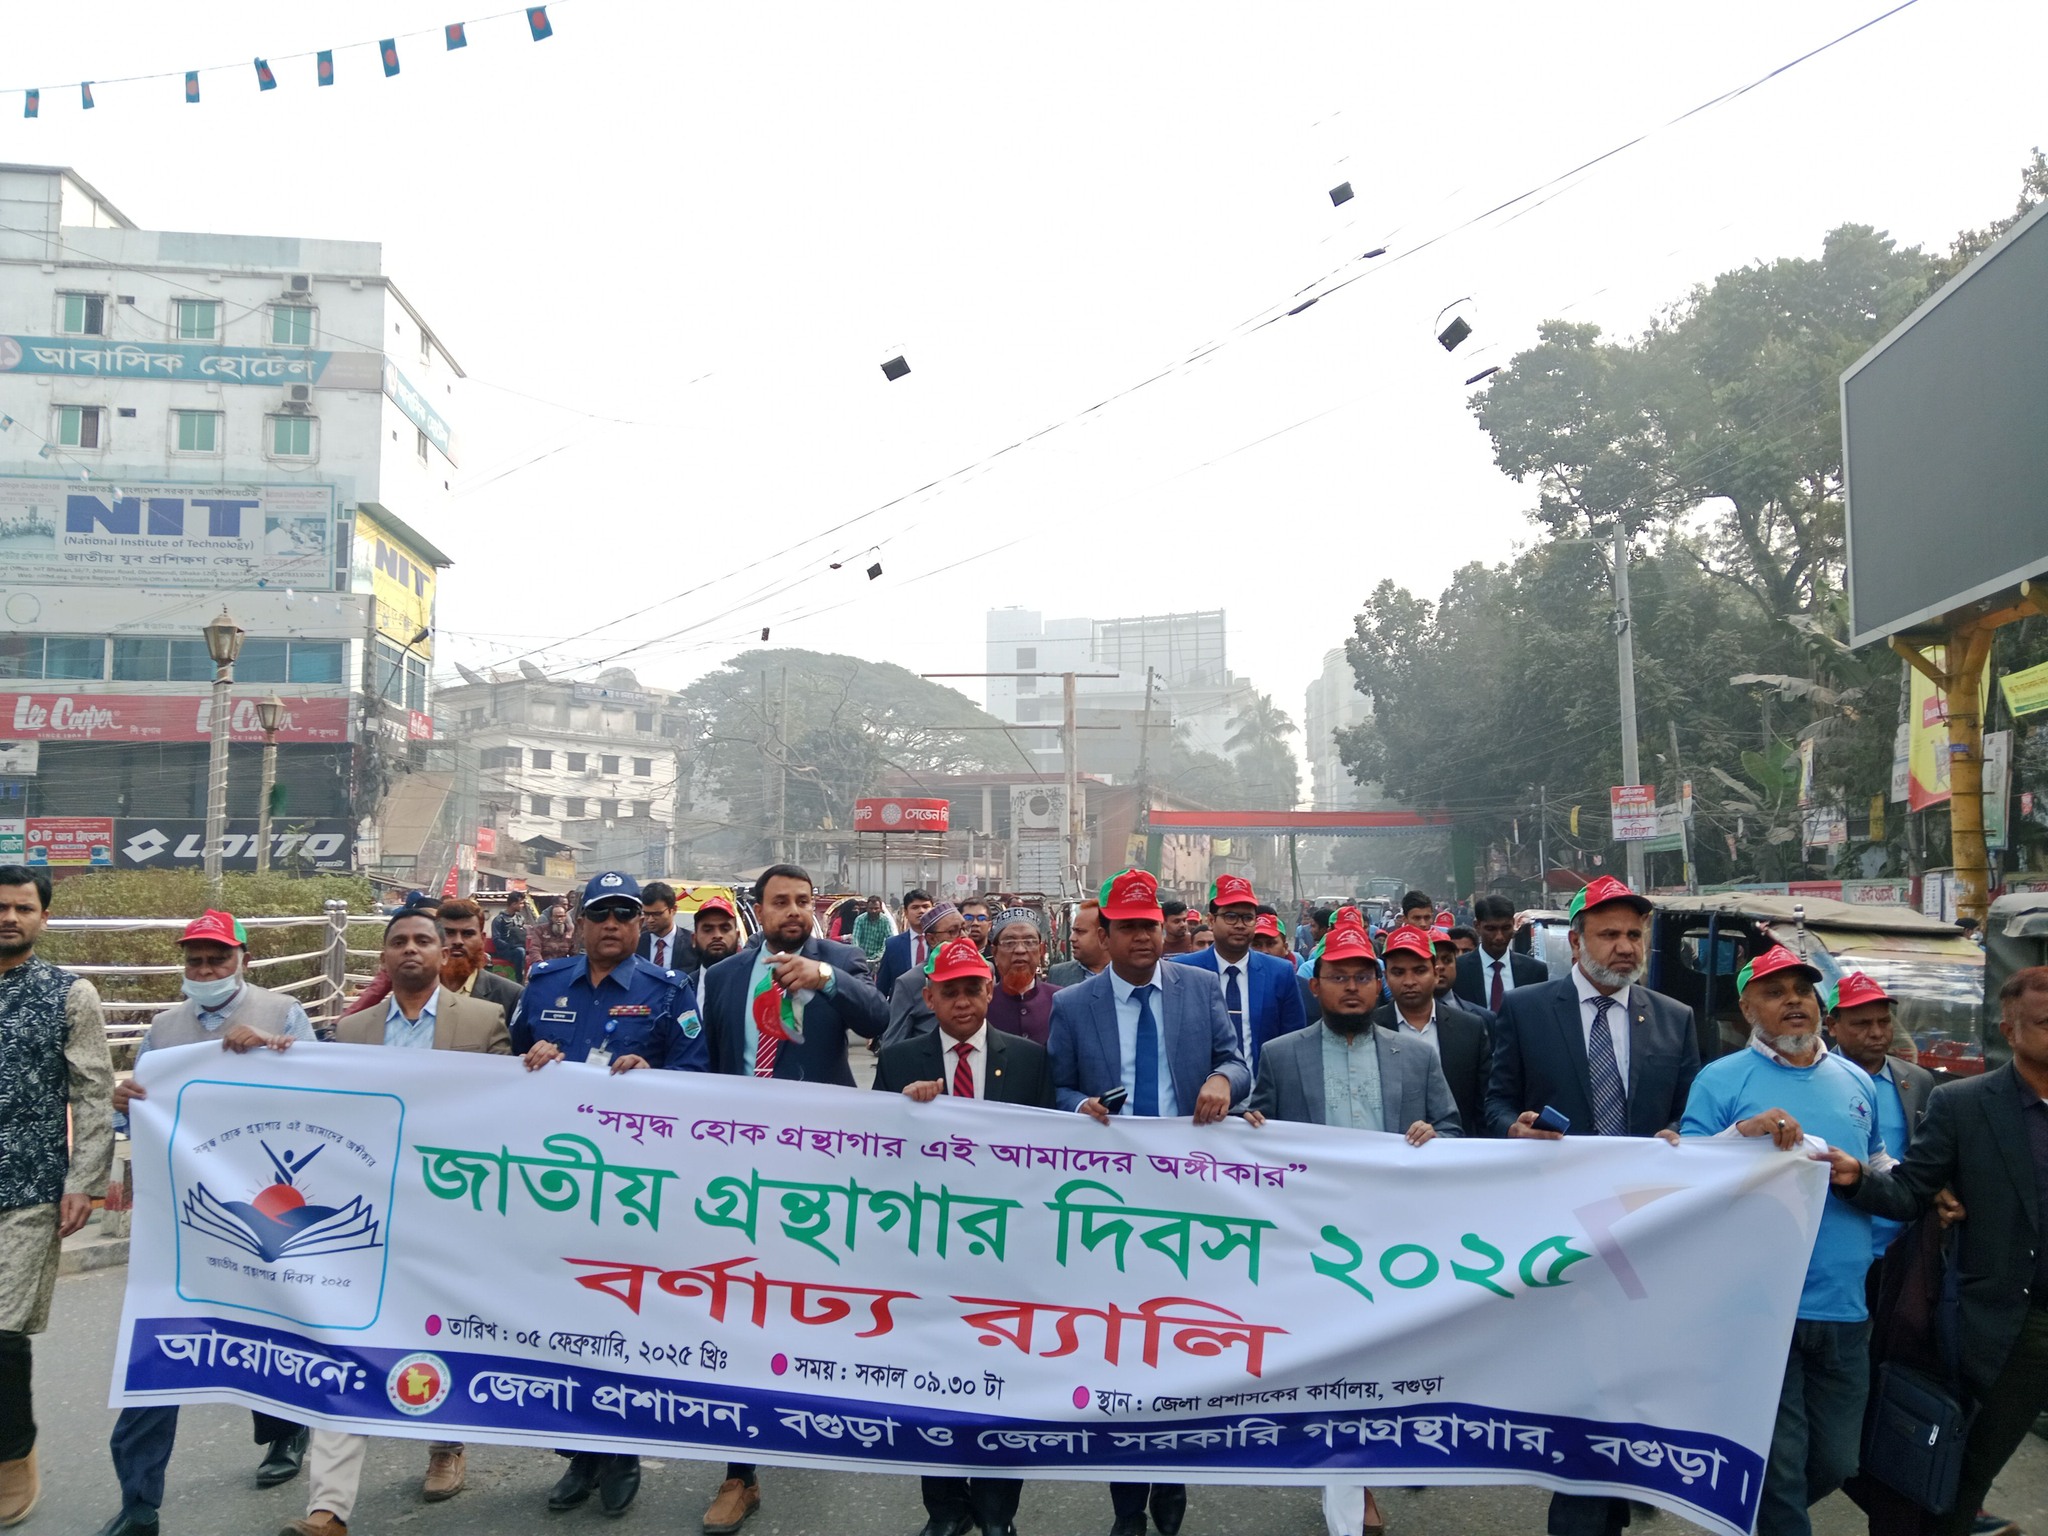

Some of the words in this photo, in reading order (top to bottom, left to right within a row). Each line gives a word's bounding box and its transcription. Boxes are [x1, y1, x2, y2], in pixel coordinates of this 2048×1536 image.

[31, 345, 185, 374] আবাসিক
[200, 352, 316, 380] হোটেল
[66, 495, 259, 537] NIT
[64, 535, 118, 546] (National
[120, 537, 171, 548] Institute
[172, 538, 184, 548] of
[187, 539, 254, 551] Technology)
[64, 551, 113, 563] জাতীয়
[120, 553, 144, 565] যুব
[375, 537, 431, 600] NIT
[49, 696, 123, 739] Cooper
[173, 833, 346, 858] LOTTO
[286, 1119, 302, 1132] এই
[304, 1122, 344, 1145] আমাদের
[577, 1103, 679, 1145] “সমৃদ্ধ
[691, 1119, 769, 1146] হোক
[777, 1124, 907, 1159] গ্রন্থাগার
[921, 1134, 978, 1167] এই
[989, 1142, 1137, 1175] আমাদের
[1147, 1151, 1307, 1189] অঙ্গীকার”
[413, 1132, 681, 1233] জাতীয়
[694, 1166, 1023, 1266] গ্রন্থাগার
[1043, 1178, 1279, 1287] দিবস
[1310, 1224, 1593, 1304] ২০২৫
[282, 1267, 316, 1285] দিবস
[321, 1276, 352, 1288] ২০২৫
[561, 1256, 924, 1339] বর্ণাঢ্য
[447, 1314, 498, 1342] তারিখ
[516, 1330, 541, 1349] ০৫
[548, 1328, 630, 1365] ফেব্রুয়ারি,
[639, 1340, 692, 1367] ২০২৫
[794, 1356, 837, 1383] সময়
[855, 1362, 908, 1391] সকাল
[914, 1373, 977, 1396] ০৯.৩০
[984, 1369, 1006, 1400] টা
[1095, 1388, 1133, 1416] স্থান
[1152, 1395, 1202, 1413] জেলা
[1207, 1387, 1298, 1411] প্রশাসকের
[1305, 1377, 1384, 1403] কার্যালয়,
[1392, 1374, 1445, 1397] বগুড়া
[468, 1369, 581, 1412] জেলা
[592, 1383, 760, 1439] প্রশাসন,
[774, 1406, 910, 1449] বগুড়া
[916, 1426, 954, 1447] ও
[977, 1429, 1098, 1455] জেলা
[1108, 1417, 1288, 1452] সরকারি
[1302, 1411, 1566, 1465] গণগ্রন্থাগার,
[1586, 1434, 1730, 1492] বগুড়া
